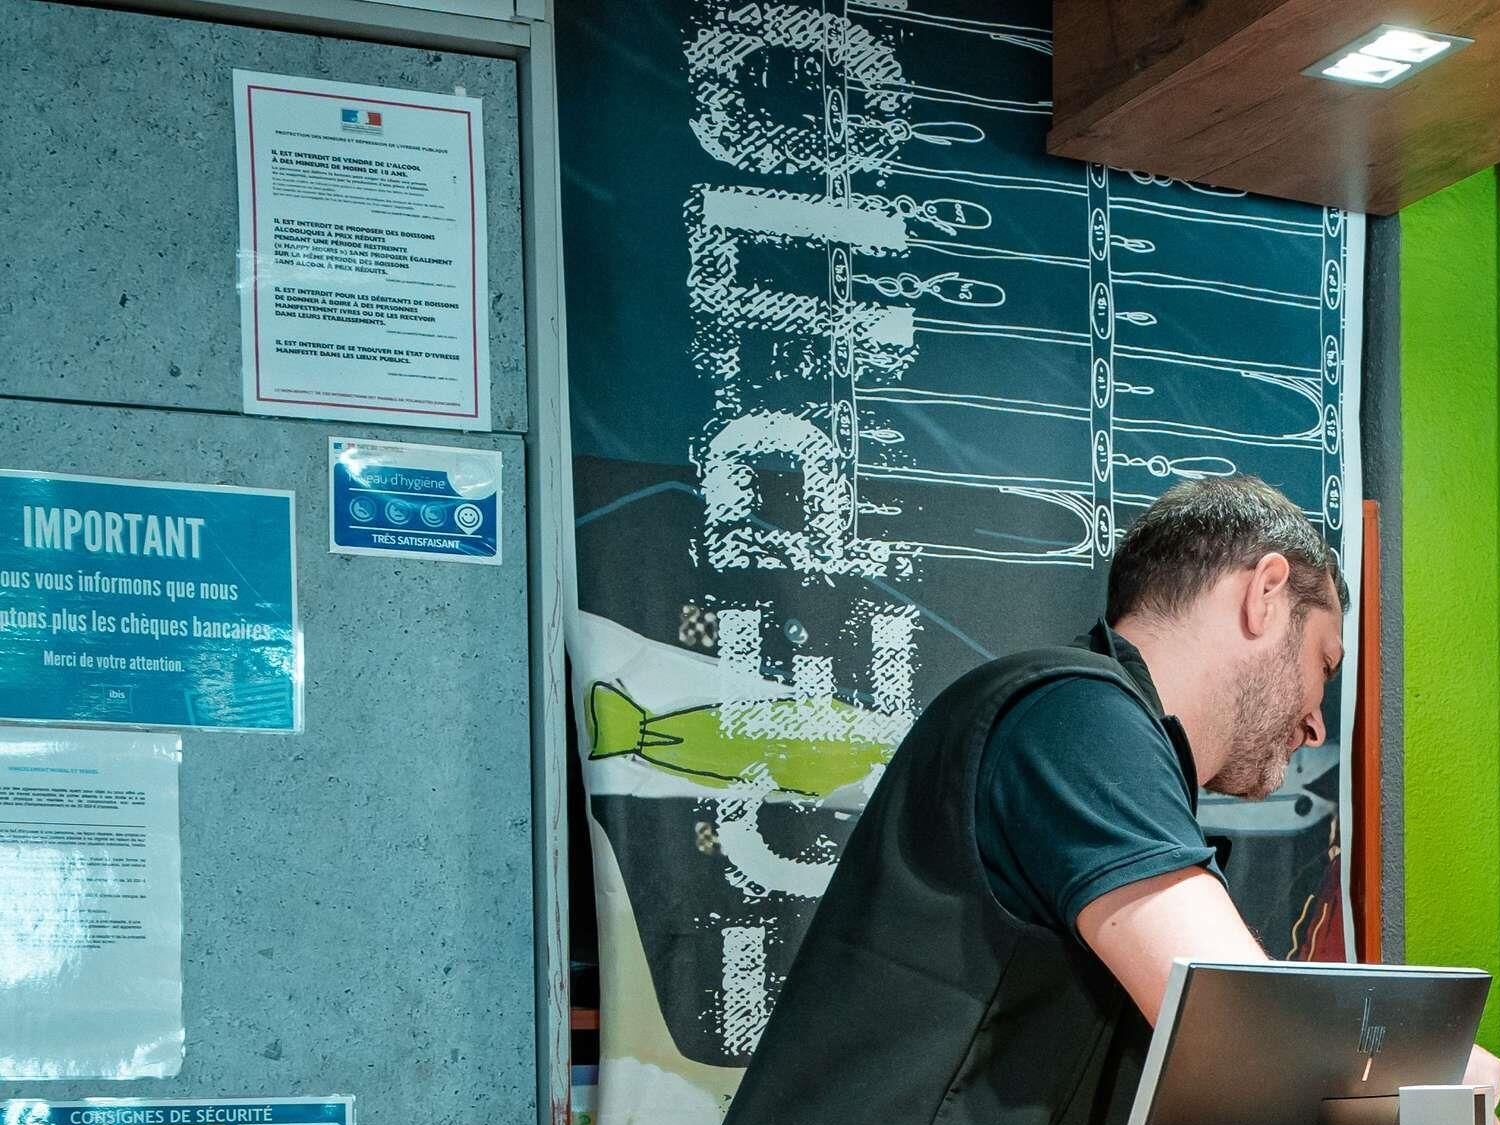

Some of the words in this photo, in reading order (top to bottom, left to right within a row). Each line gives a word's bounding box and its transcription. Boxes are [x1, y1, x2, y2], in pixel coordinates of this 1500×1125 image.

[294, 152, 330, 161] INTERDIT
[343, 157, 372, 165] VENDRE
[295, 159, 329, 168] MINEURS
[342, 164, 367, 172] MOINS
[296, 220, 332, 229] INTERDIT
[345, 225, 383, 234] PROPOSER
[400, 231, 435, 240] BOISSONS
[274, 234, 311, 243] PENDANT
[297, 288, 332, 297] INTERDIT
[424, 300, 459, 309] BOISSONS
[375, 304, 418, 313] PERSONNES
[399, 314, 435, 322] RECEVOIR
[276, 346, 317, 355] MANIFESTE
[355, 353, 376, 361] LIEUX
[298, 341, 334, 349] INTERDIT
[357, 346, 391, 354] TROUVER
[24, 505, 205, 559] IMPORTANT
[372, 534, 396, 545] TRÈS
[398, 536, 460, 549] SATISFAISANT
[0, 571, 30, 589] ous
[35, 572, 73, 591] vous
[78, 570, 161, 597] informons
[166, 580, 195, 602] que
[200, 582, 238, 600] nous
[0, 607, 47, 632] ptons
[52, 608, 87, 634] plus
[92, 610, 116, 633] les
[121, 612, 188, 640] chèques
[193, 616, 271, 641] bancaires
[44, 650, 77, 666] Merci
[80, 652, 93, 668] de
[96, 654, 126, 669] votre
[129, 656, 185, 672] attention.
[109, 690, 125, 699] ibis
[70, 1110, 164, 1125] CONSIGNES
[170, 1110, 191, 1123] DE
[196, 1105, 273, 1122] SÉCURITÉ
